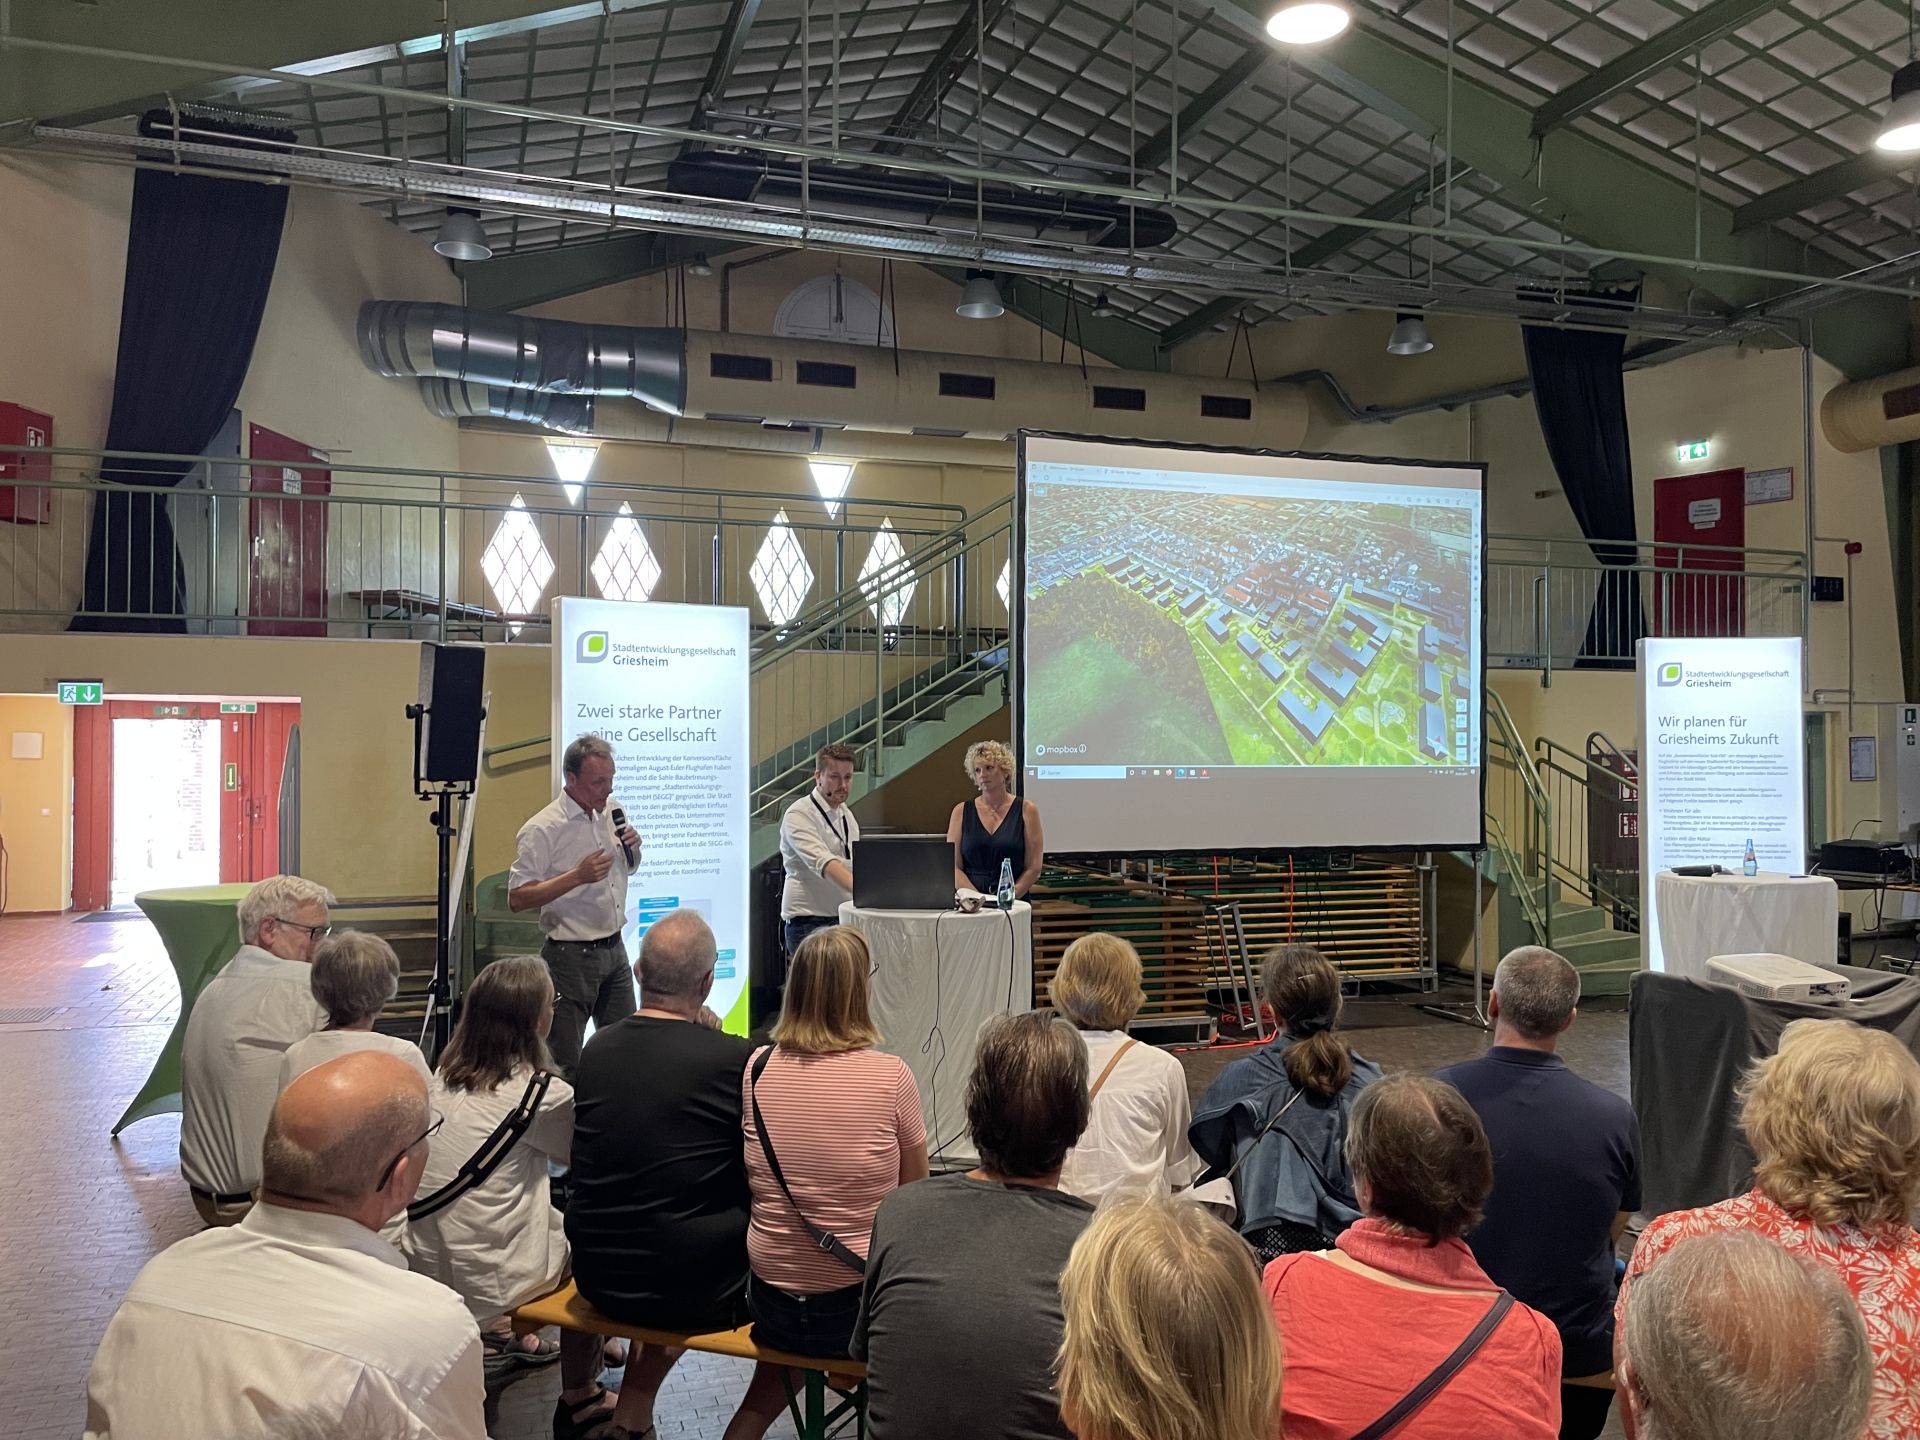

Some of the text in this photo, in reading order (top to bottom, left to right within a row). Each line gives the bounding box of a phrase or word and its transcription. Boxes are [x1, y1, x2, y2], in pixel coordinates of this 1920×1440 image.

[612, 643, 737, 657] Stadtentwicklungsgesellschaft
[612, 655, 669, 667] Griesheim
[1685, 670, 1790, 679] Stadtentwicklungsgesellschaft
[1685, 679, 1732, 688] Griesheim
[577, 703, 722, 720] Zwei starke Partner
[1658, 715, 1748, 730] Wir planen für
[628, 727, 717, 742] Gesellschaft
[1658, 733, 1780, 745] Griesheims Zukunft
[1046, 744, 1079, 754] mapbox
